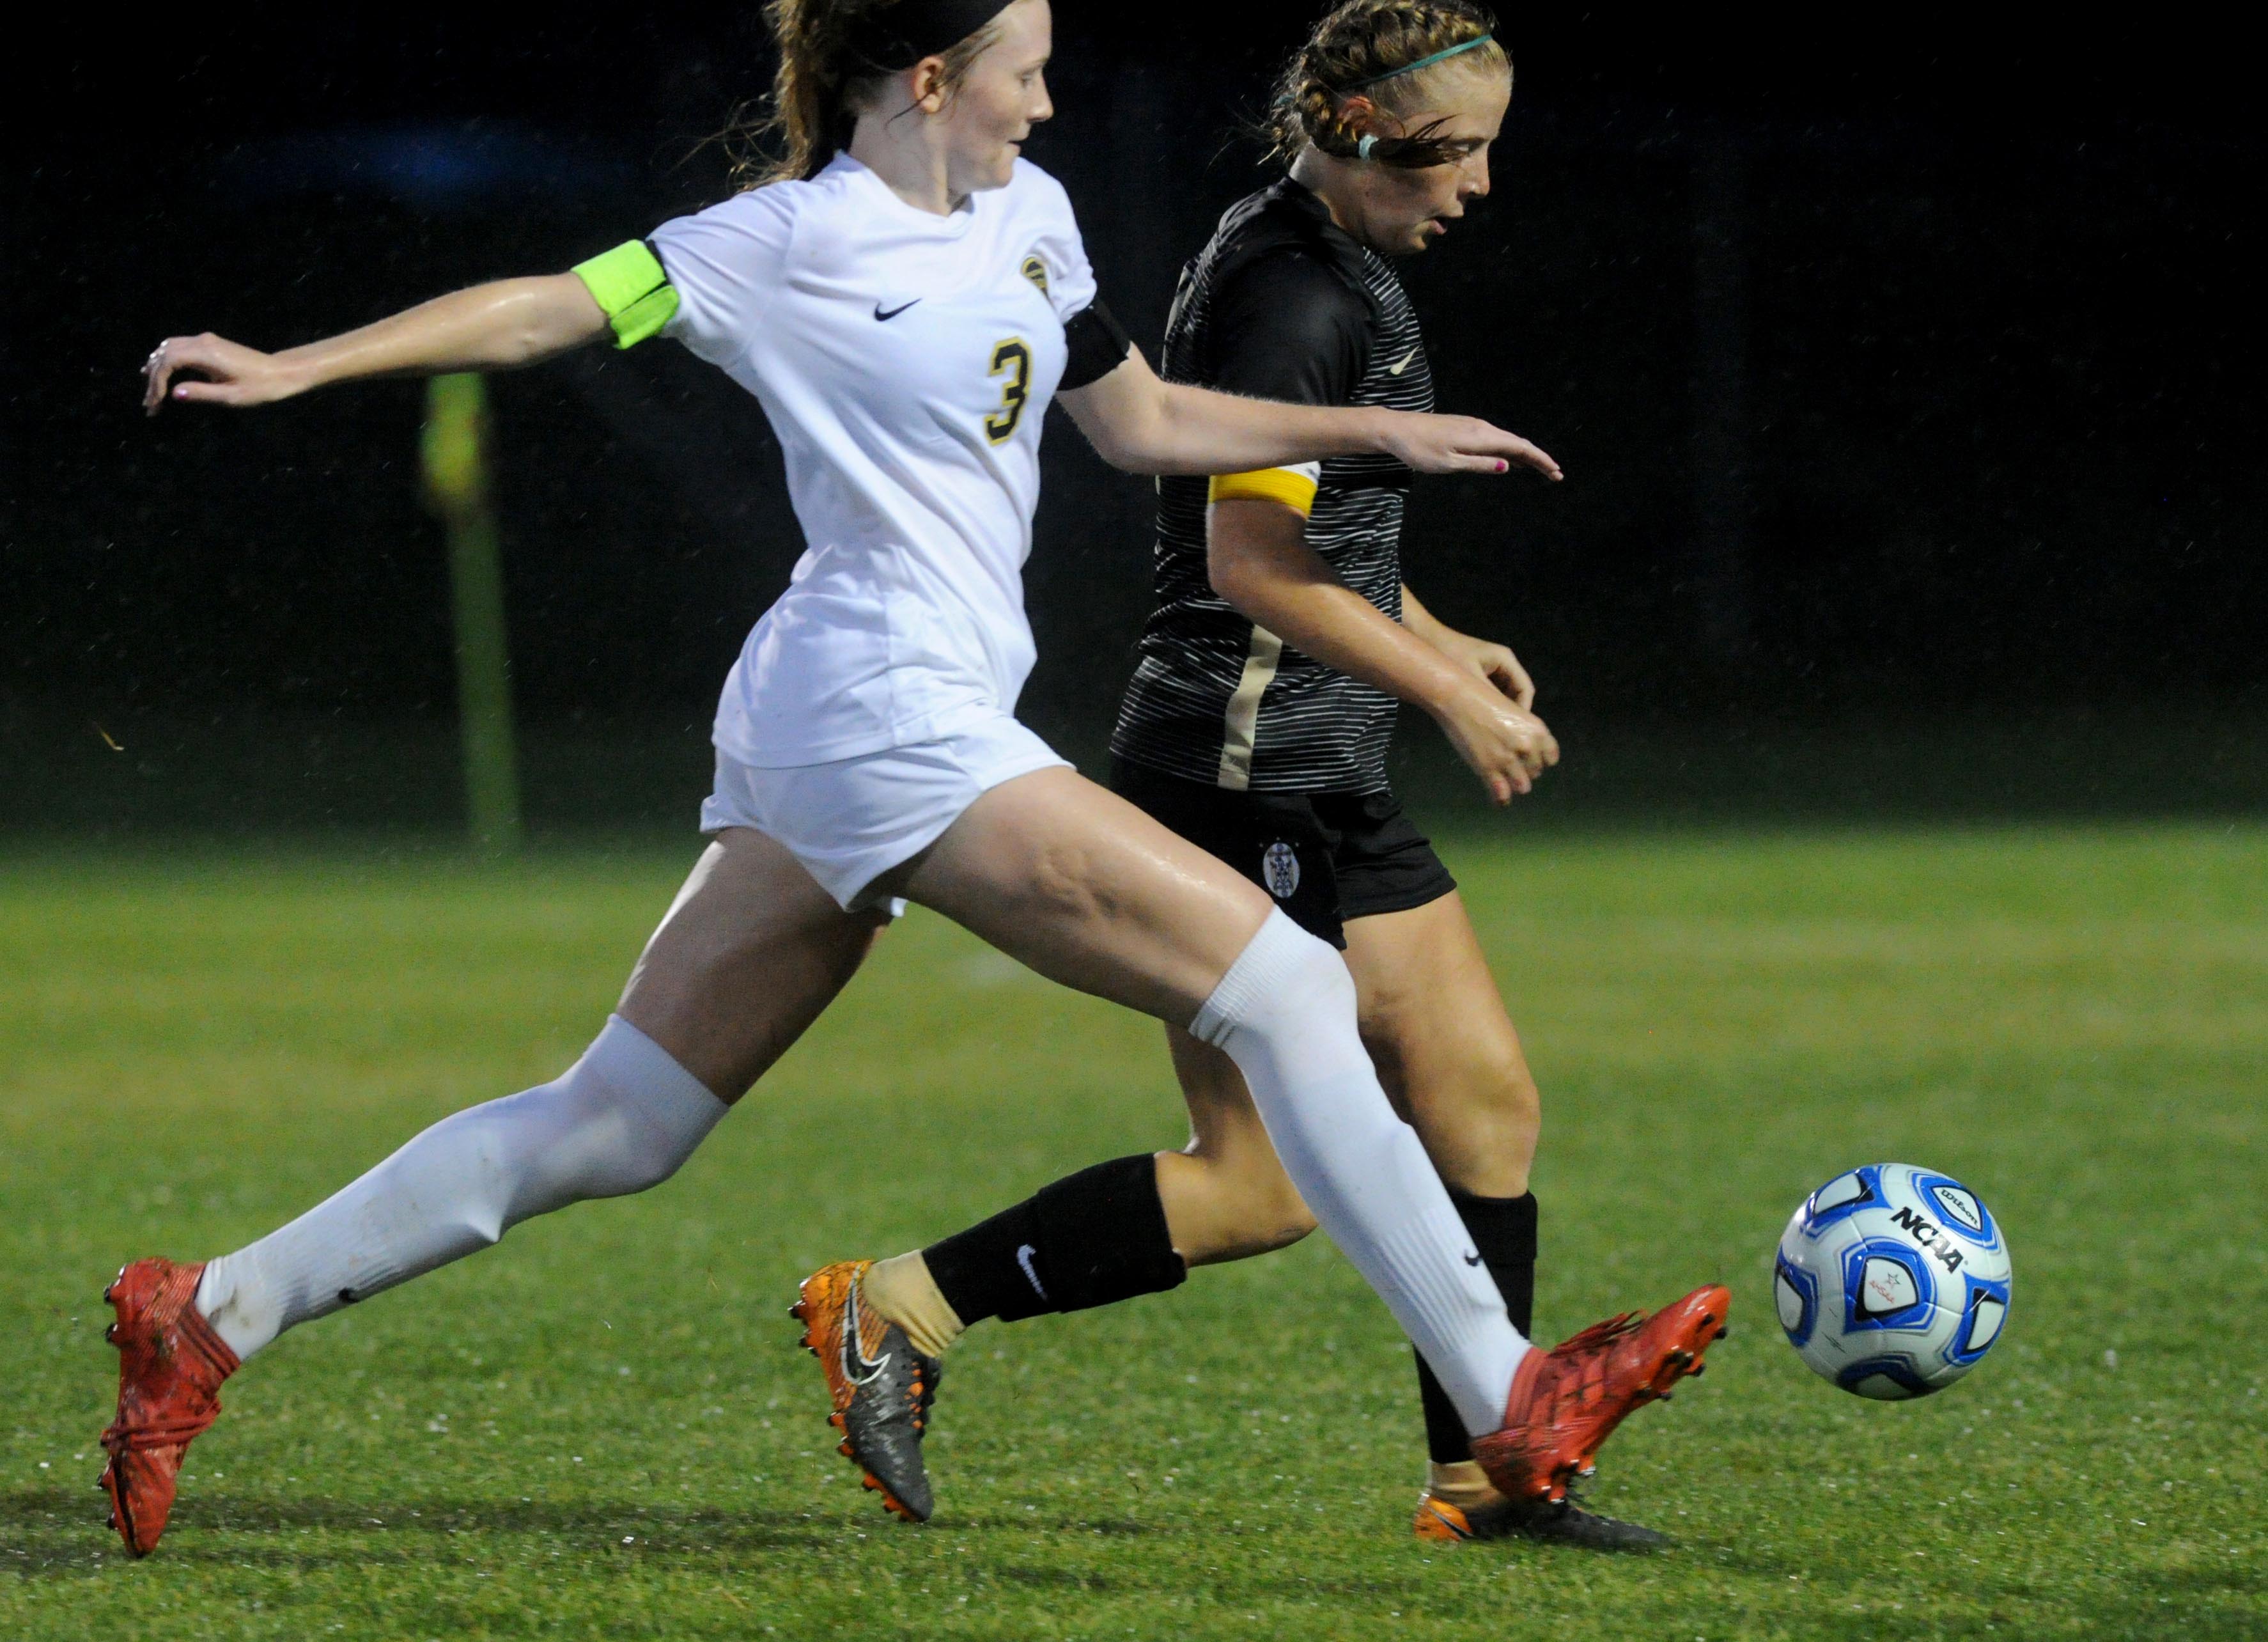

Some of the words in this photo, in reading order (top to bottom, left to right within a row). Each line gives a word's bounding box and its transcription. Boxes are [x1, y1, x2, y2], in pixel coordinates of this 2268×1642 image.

[984, 336, 1033, 446] 3
[1890, 1206, 1964, 1274] NCAA
[1941, 1188, 1978, 1226] Wilson
